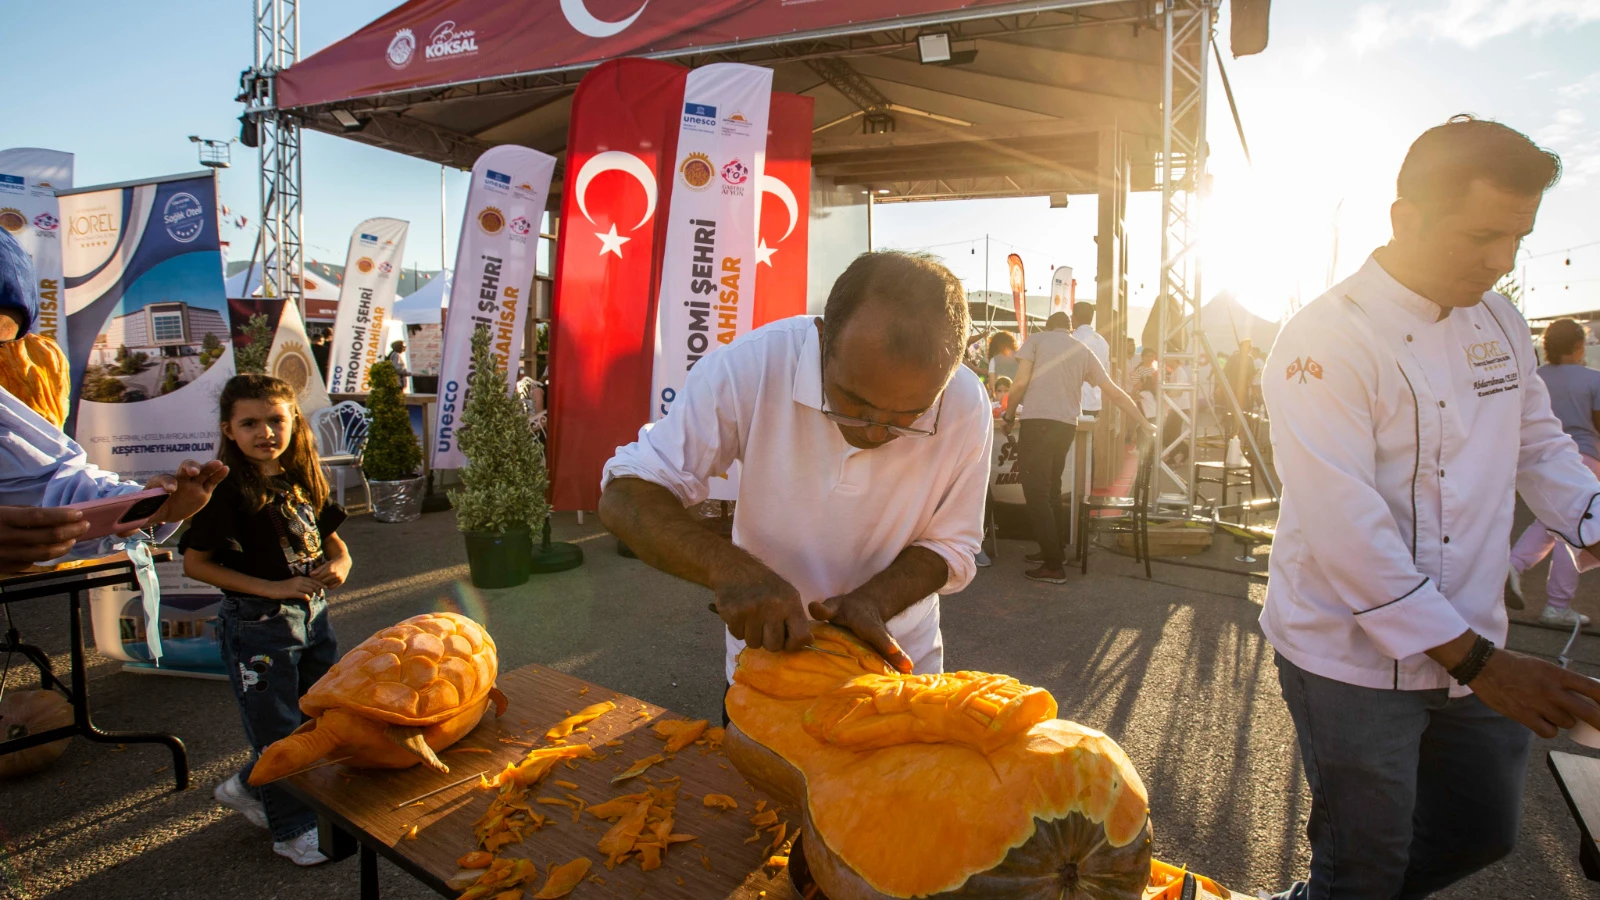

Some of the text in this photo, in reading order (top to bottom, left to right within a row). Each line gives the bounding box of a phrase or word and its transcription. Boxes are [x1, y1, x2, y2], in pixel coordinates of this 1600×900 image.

[425, 38, 479, 58] KÖKSAL
[683, 116, 716, 126] unesco
[484, 179, 510, 190] unesco
[67, 213, 118, 247] KOREL
[689, 218, 718, 296] ŞEHRİ
[478, 254, 503, 314] ŞEHRİ
[713, 256, 742, 345] AHİSAR
[344, 286, 374, 393] STRONOMİ ŞEHRİ
[361, 306, 385, 392] ONKARAHİSAR
[684, 301, 711, 372] NOMİ
[1462, 341, 1508, 375] KOREL
[331, 365, 343, 394] esco
[438, 380, 459, 452] unesco
[112, 442, 214, 456] KEŞFETMEYE HAZIR OLUN
